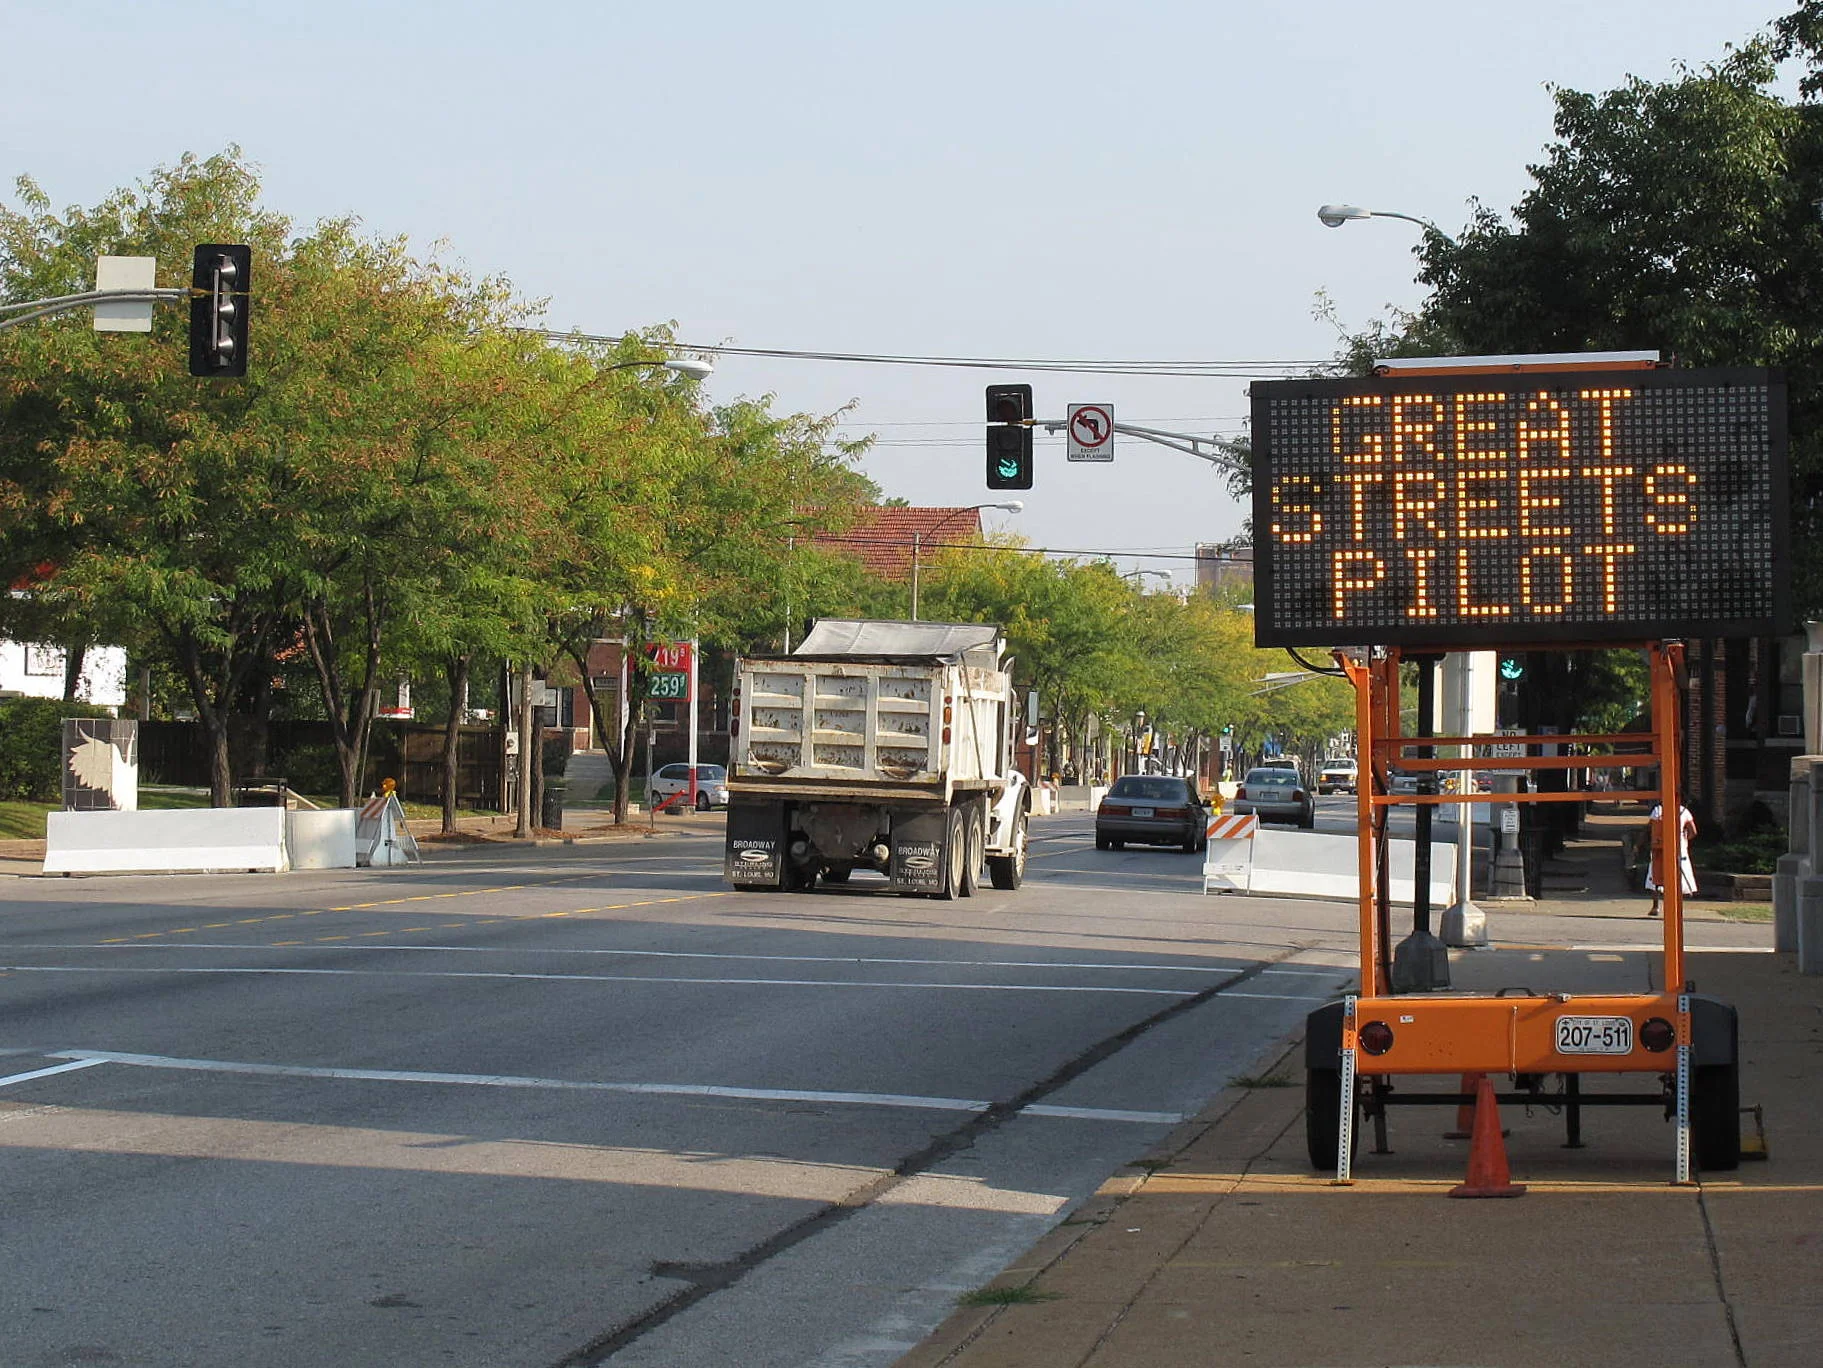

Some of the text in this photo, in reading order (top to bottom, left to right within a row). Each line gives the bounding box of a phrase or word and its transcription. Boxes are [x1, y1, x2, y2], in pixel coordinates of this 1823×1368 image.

[1332, 388, 1632, 463] GREAT
[1271, 464, 1698, 543] STREETS
[1334, 544, 1635, 618] PILOT
[733, 840, 776, 849] BROADWAY
[898, 846, 940, 857] BROADWAY
[1560, 1026, 1628, 1047] 207-511
